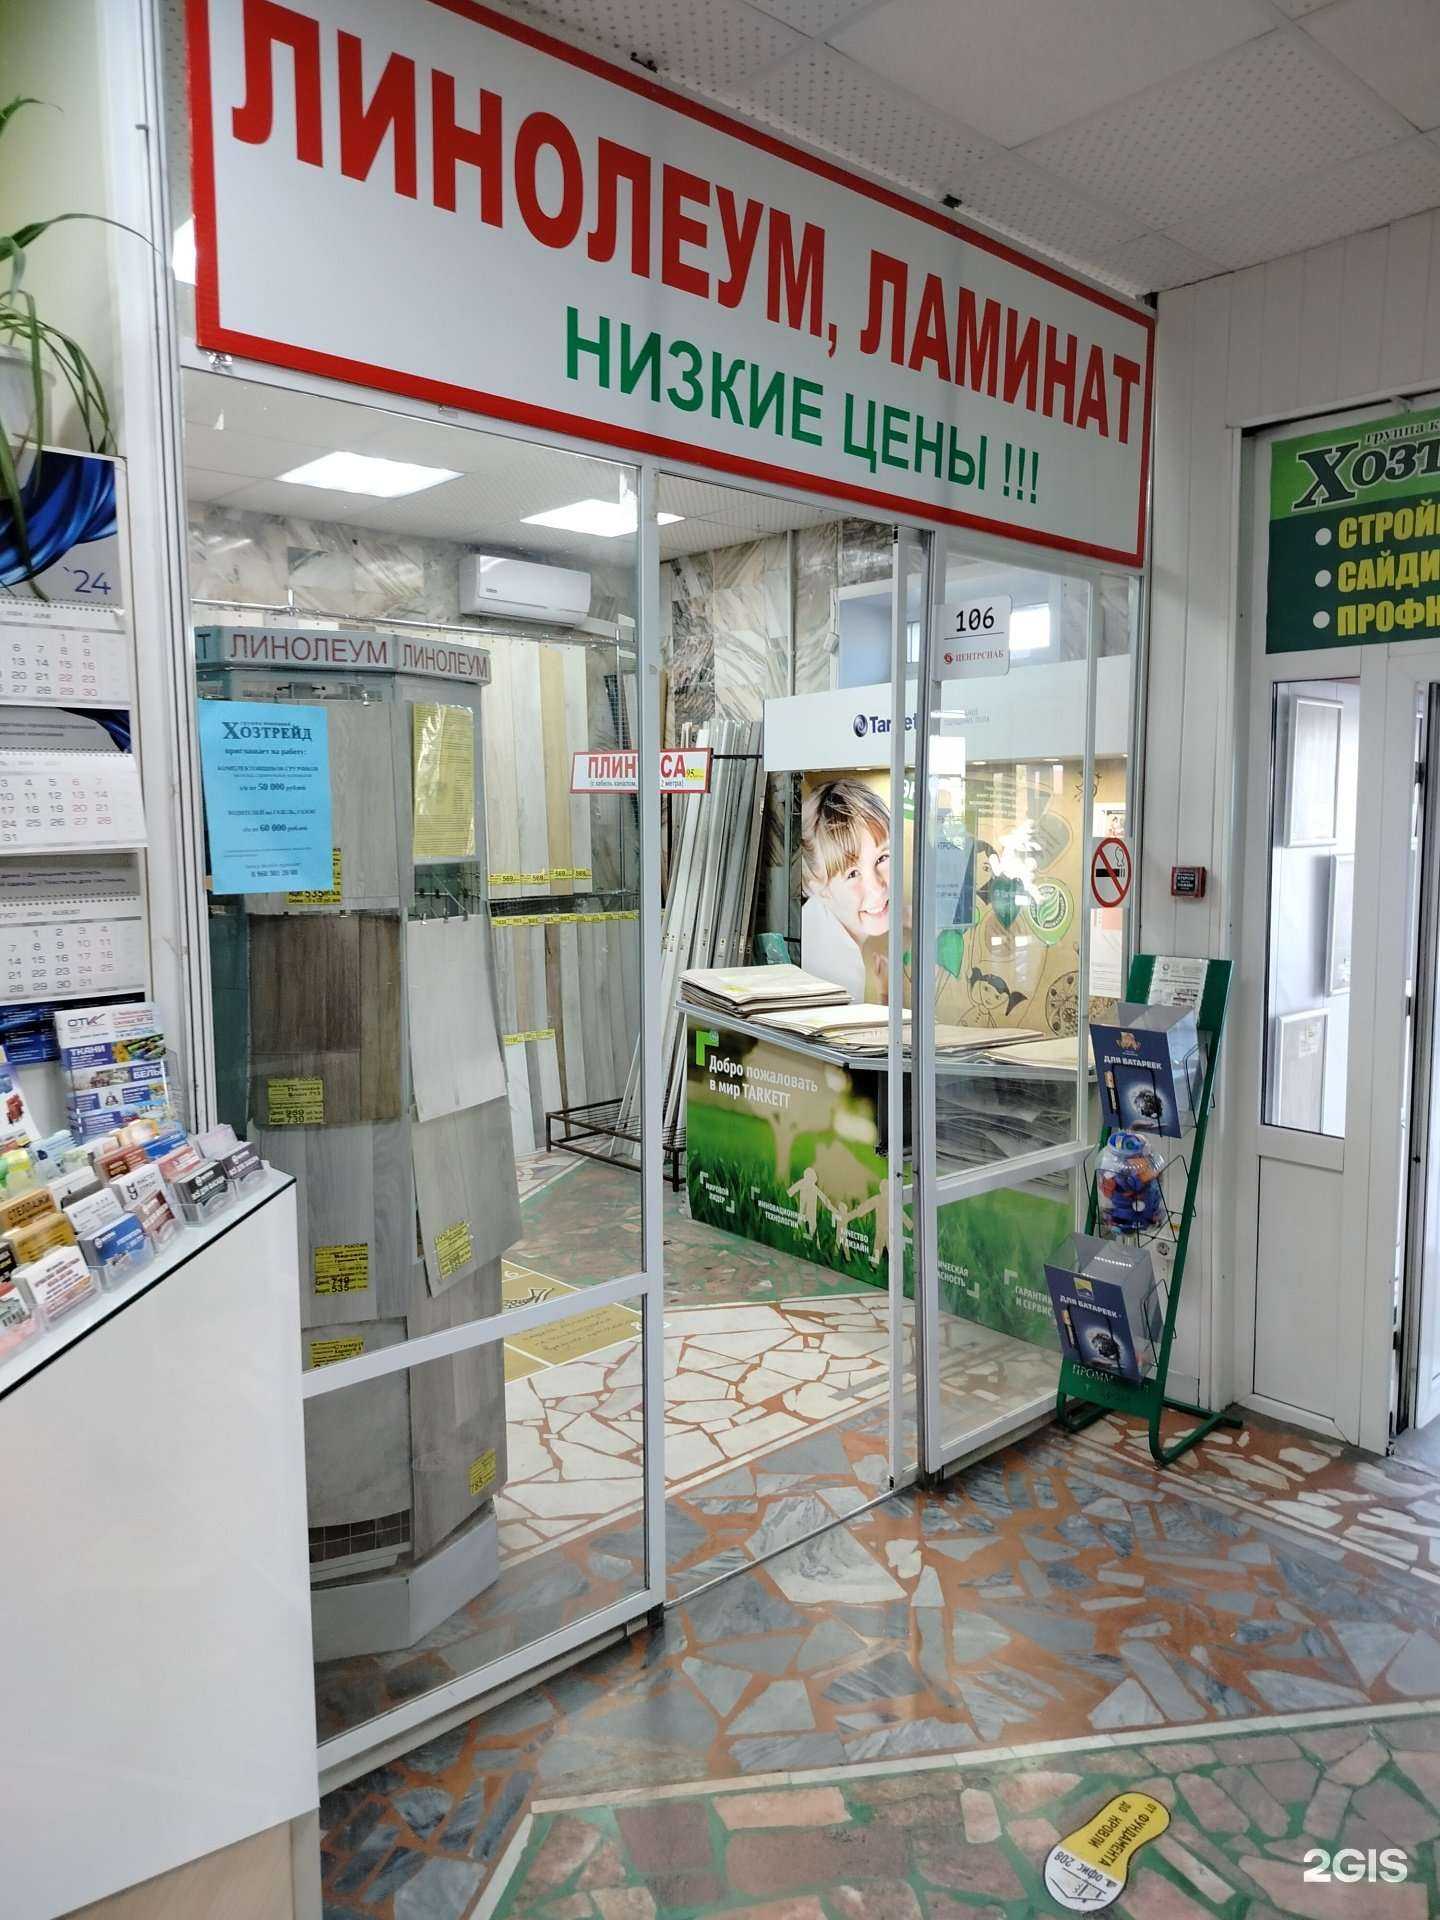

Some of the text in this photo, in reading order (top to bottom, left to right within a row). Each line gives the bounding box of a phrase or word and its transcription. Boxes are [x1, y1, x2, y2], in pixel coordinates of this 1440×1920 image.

[232, 0, 1141, 445] ЛИНОЛЕУМ, ЛАМИНАТ
[566, 306, 1040, 504] НИЗКИЕ ЦЕНЫ !!!
[1365, 422, 1425, 447] группа
[1338, 498, 1440, 550] СТРОЙ
[955, 606, 995, 633] 106
[230, 634, 388, 665] ЛИНОЛЕУМ
[402, 643, 488, 678] ЛИНОЛЕУМ
[955, 650, 1004, 663] ЦЕНТРСНАБ
[222, 721, 313, 741] ХОЗТРЕЙД
[869, 713, 918, 734] Taret
[588, 754, 686, 779] ПЛИНСА
[70, 1044, 106, 1056] ТКАНИ
[1104, 1055, 1162, 1070] ДЛЯ БАТАРЕЕК
[708, 1054, 819, 1093] Добро пожаловать
[709, 1082, 791, 1109] в мир TARKETT
[705, 1182, 729, 1196] МИРОВОЙ
[1060, 1294, 1118, 1318] ДЛЯ БАТАРЕЕК
[1088, 1801, 1132, 1849] ДО КРОВЛИ
[1098, 1813, 1150, 1867] ФУНДАМЕНТА
[1054, 1851, 1075, 1867] 208
